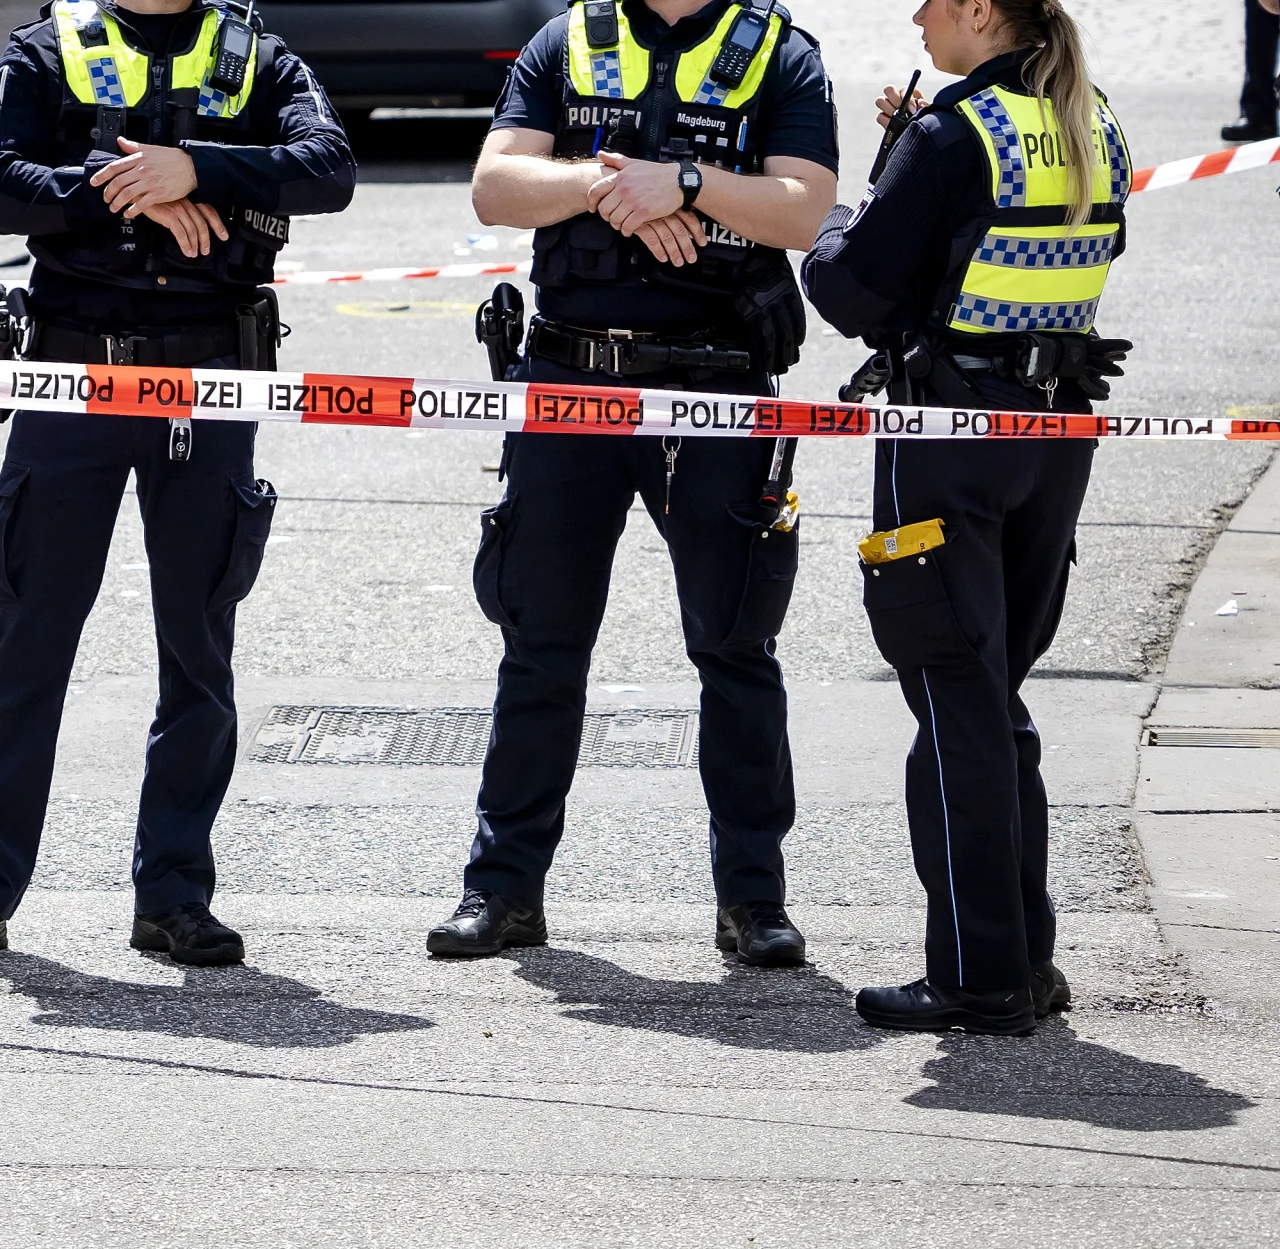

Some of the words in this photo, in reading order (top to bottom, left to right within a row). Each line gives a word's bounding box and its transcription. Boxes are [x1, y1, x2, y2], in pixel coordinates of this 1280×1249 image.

[676, 112, 727, 132] Magdeburg
[1022, 129, 1108, 169] POLI
[120, 226, 134, 234] TQ
[244, 209, 289, 241] POLIZEI
[691, 221, 748, 248] LIZE
[12, 371, 114, 403] POLIZEI
[138, 377, 242, 409] POLIZEI
[267, 383, 374, 415] POLIZEI
[399, 389, 508, 421] POLIZEI
[534, 395, 644, 426] POLIZEI
[671, 400, 782, 431] POLIZEI
[810, 405, 924, 434] POLIZEI
[951, 410, 1068, 438] POLIZEI
